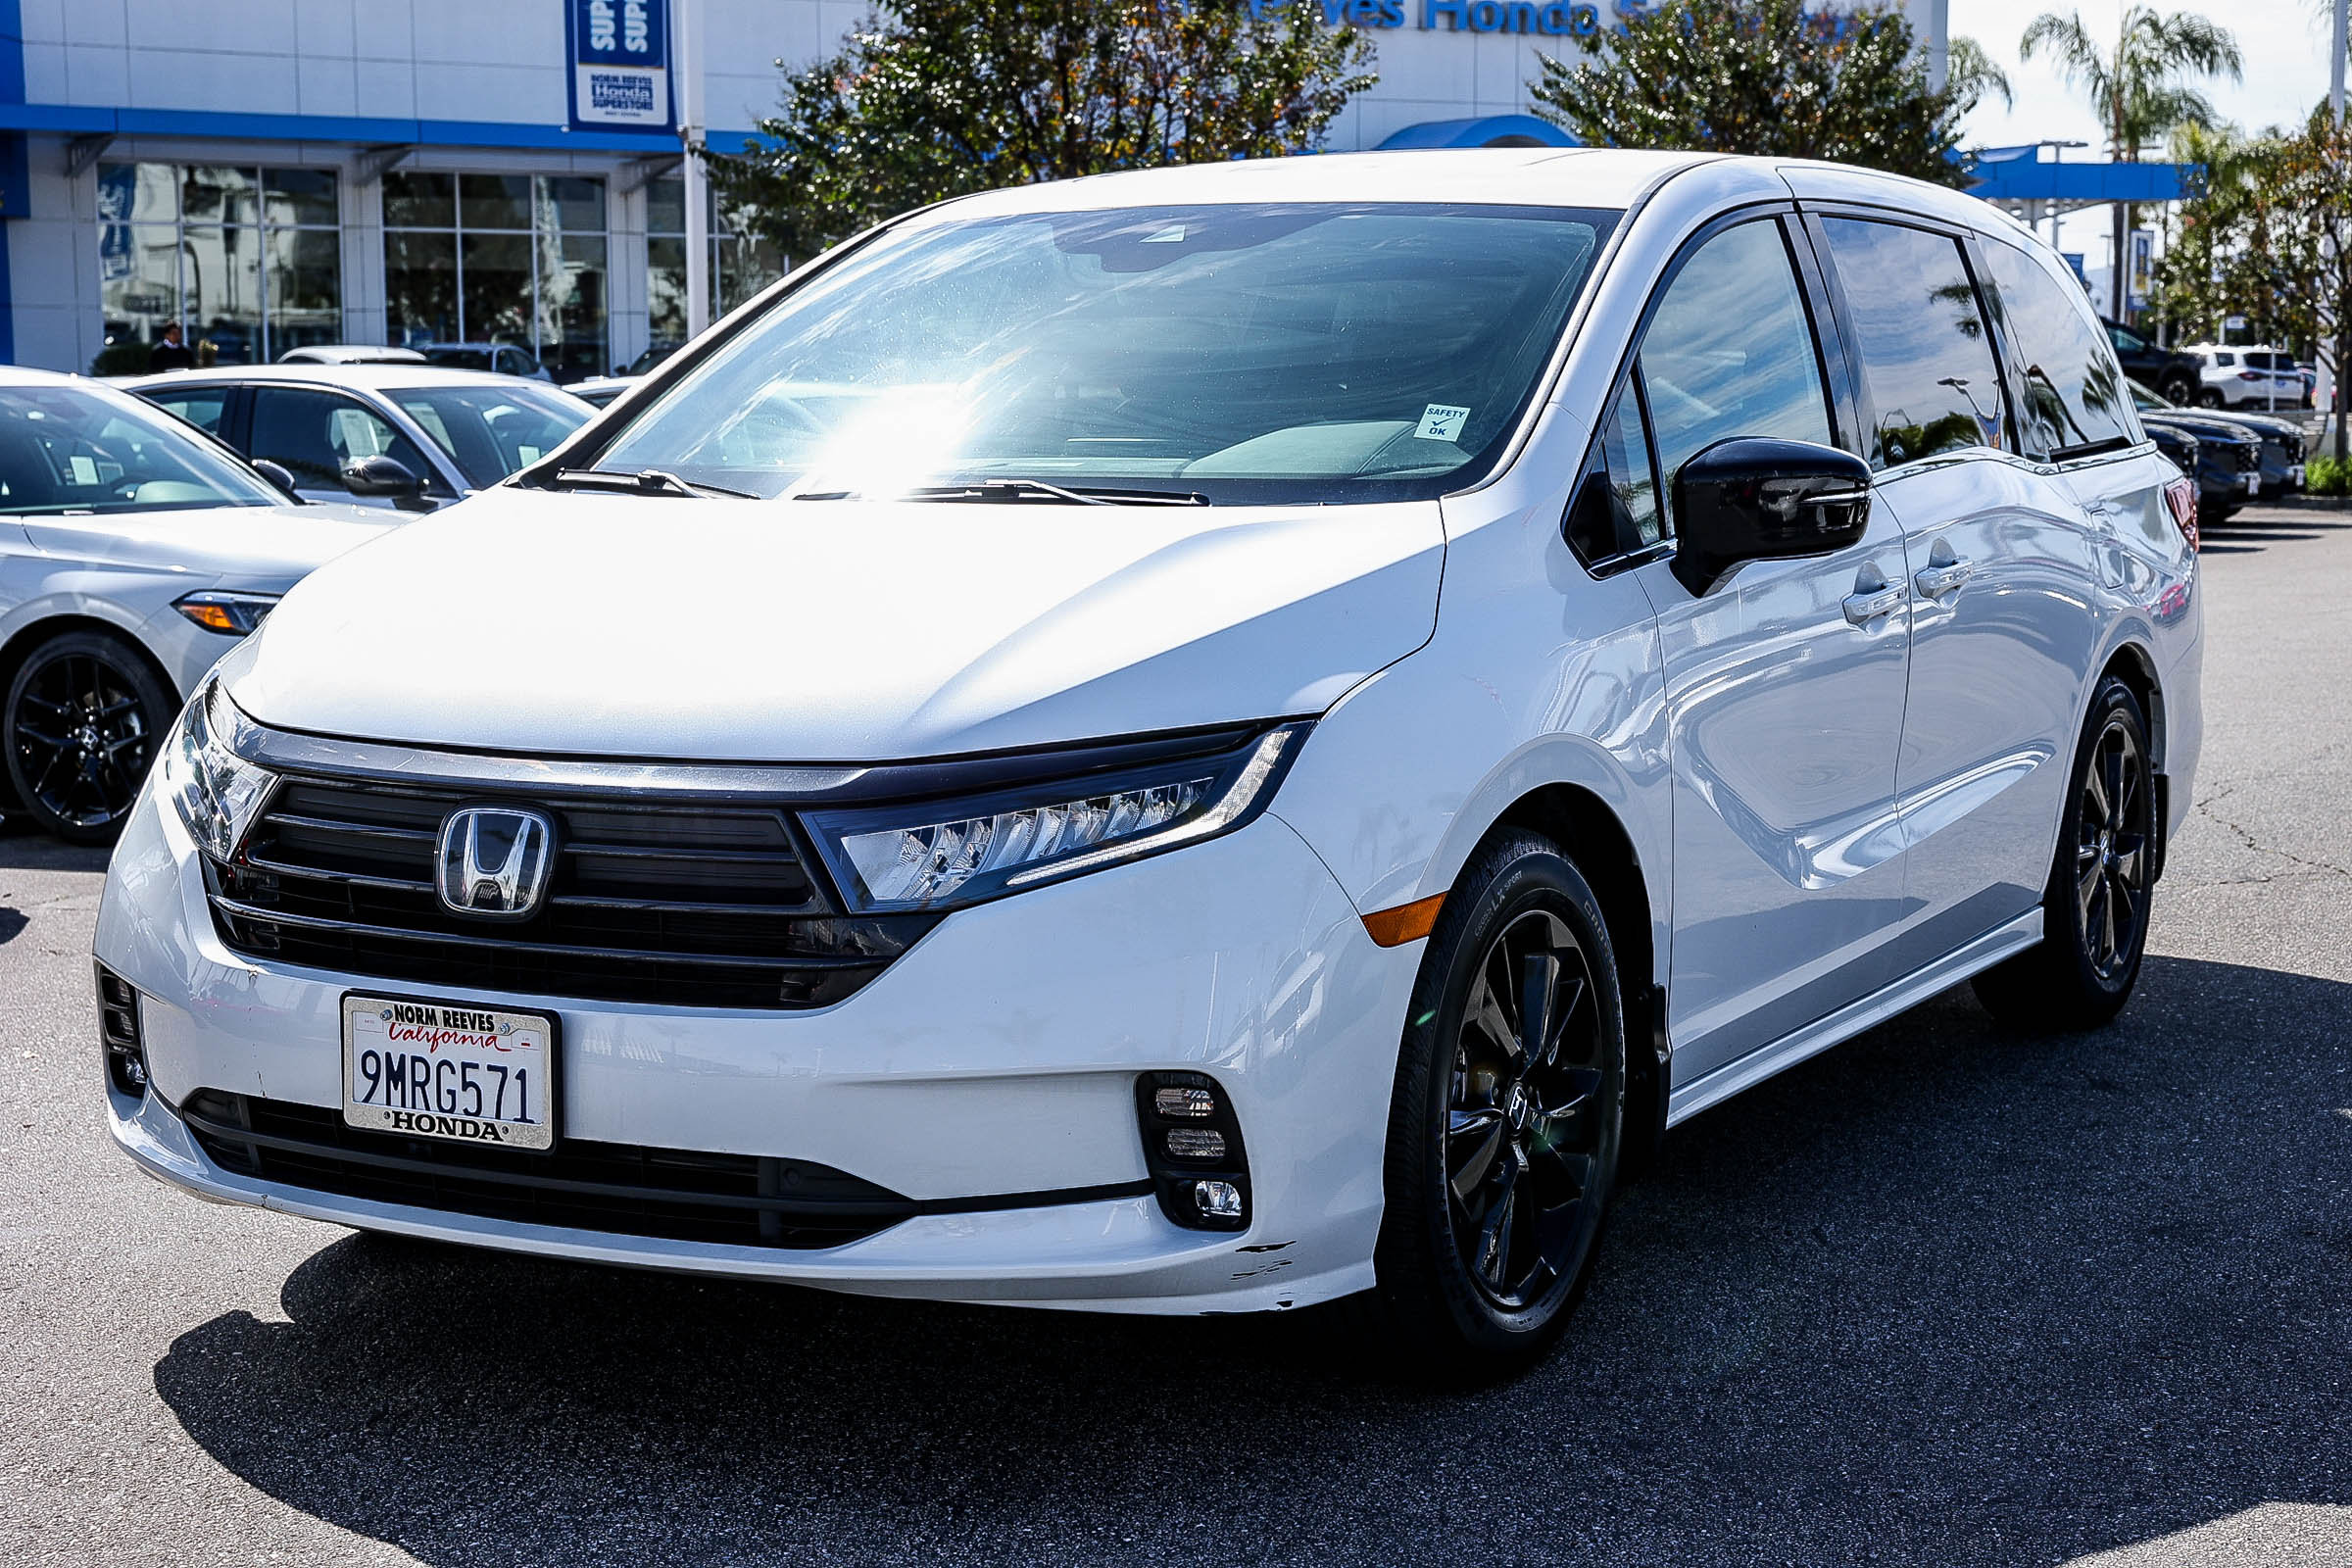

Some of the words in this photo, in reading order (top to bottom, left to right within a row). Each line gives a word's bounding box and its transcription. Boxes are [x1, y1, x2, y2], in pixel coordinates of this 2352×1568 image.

[590, 0, 615, 51] SUP
[624, 0, 648, 53] SUP
[594, 85, 651, 101] Honda
[1427, 408, 1466, 418] SAFETY
[394, 1004, 438, 1026] NORM
[443, 1011, 495, 1032] REEVES
[388, 1022, 512, 1054] California
[361, 1050, 535, 1124] 9MRG571
[392, 1110, 505, 1142] HONDA
